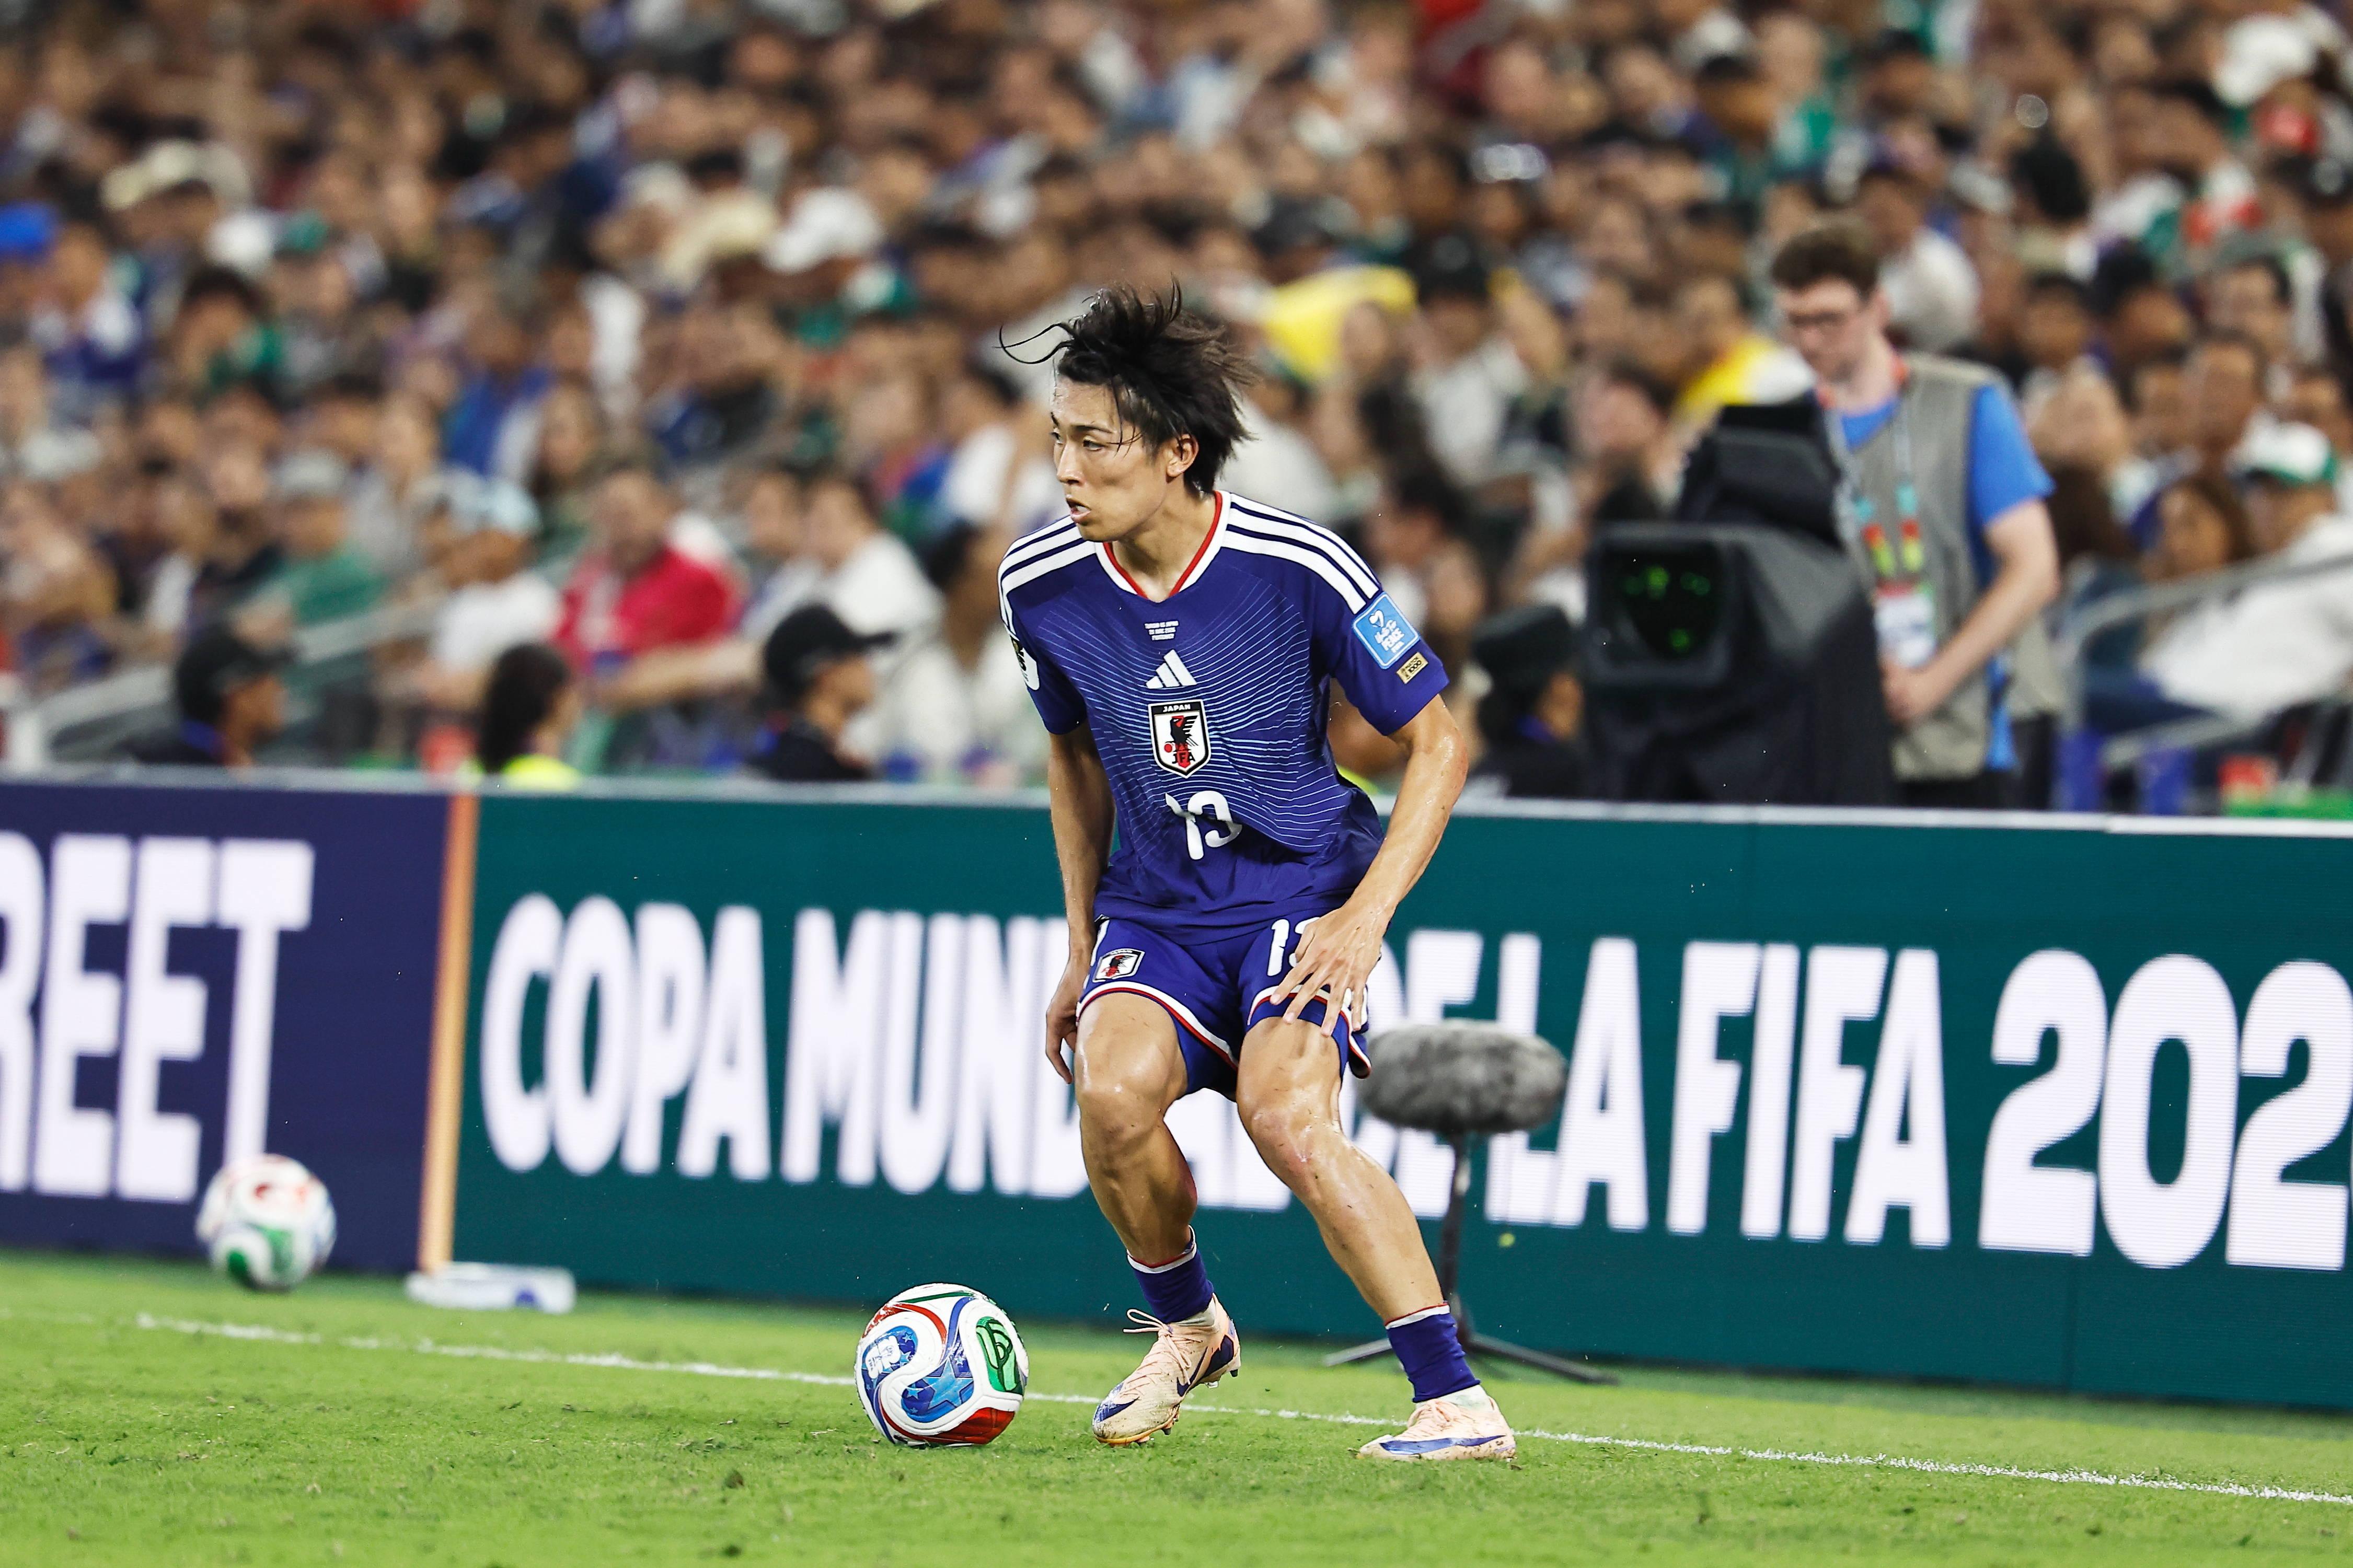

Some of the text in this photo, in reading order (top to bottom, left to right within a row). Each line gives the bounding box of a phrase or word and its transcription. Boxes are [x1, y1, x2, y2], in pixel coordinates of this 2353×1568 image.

[1162, 704, 1191, 712] JAPAN
[1172, 752, 1196, 764] JFA
[1165, 790, 1242, 860] 13
[479, 891, 771, 1182] COPA
[779, 908, 1293, 1213] MUND
[1484, 932, 1649, 1232] LA
[1666, 941, 1951, 1249] FIFA
[1978, 947, 2353, 1271] 202
